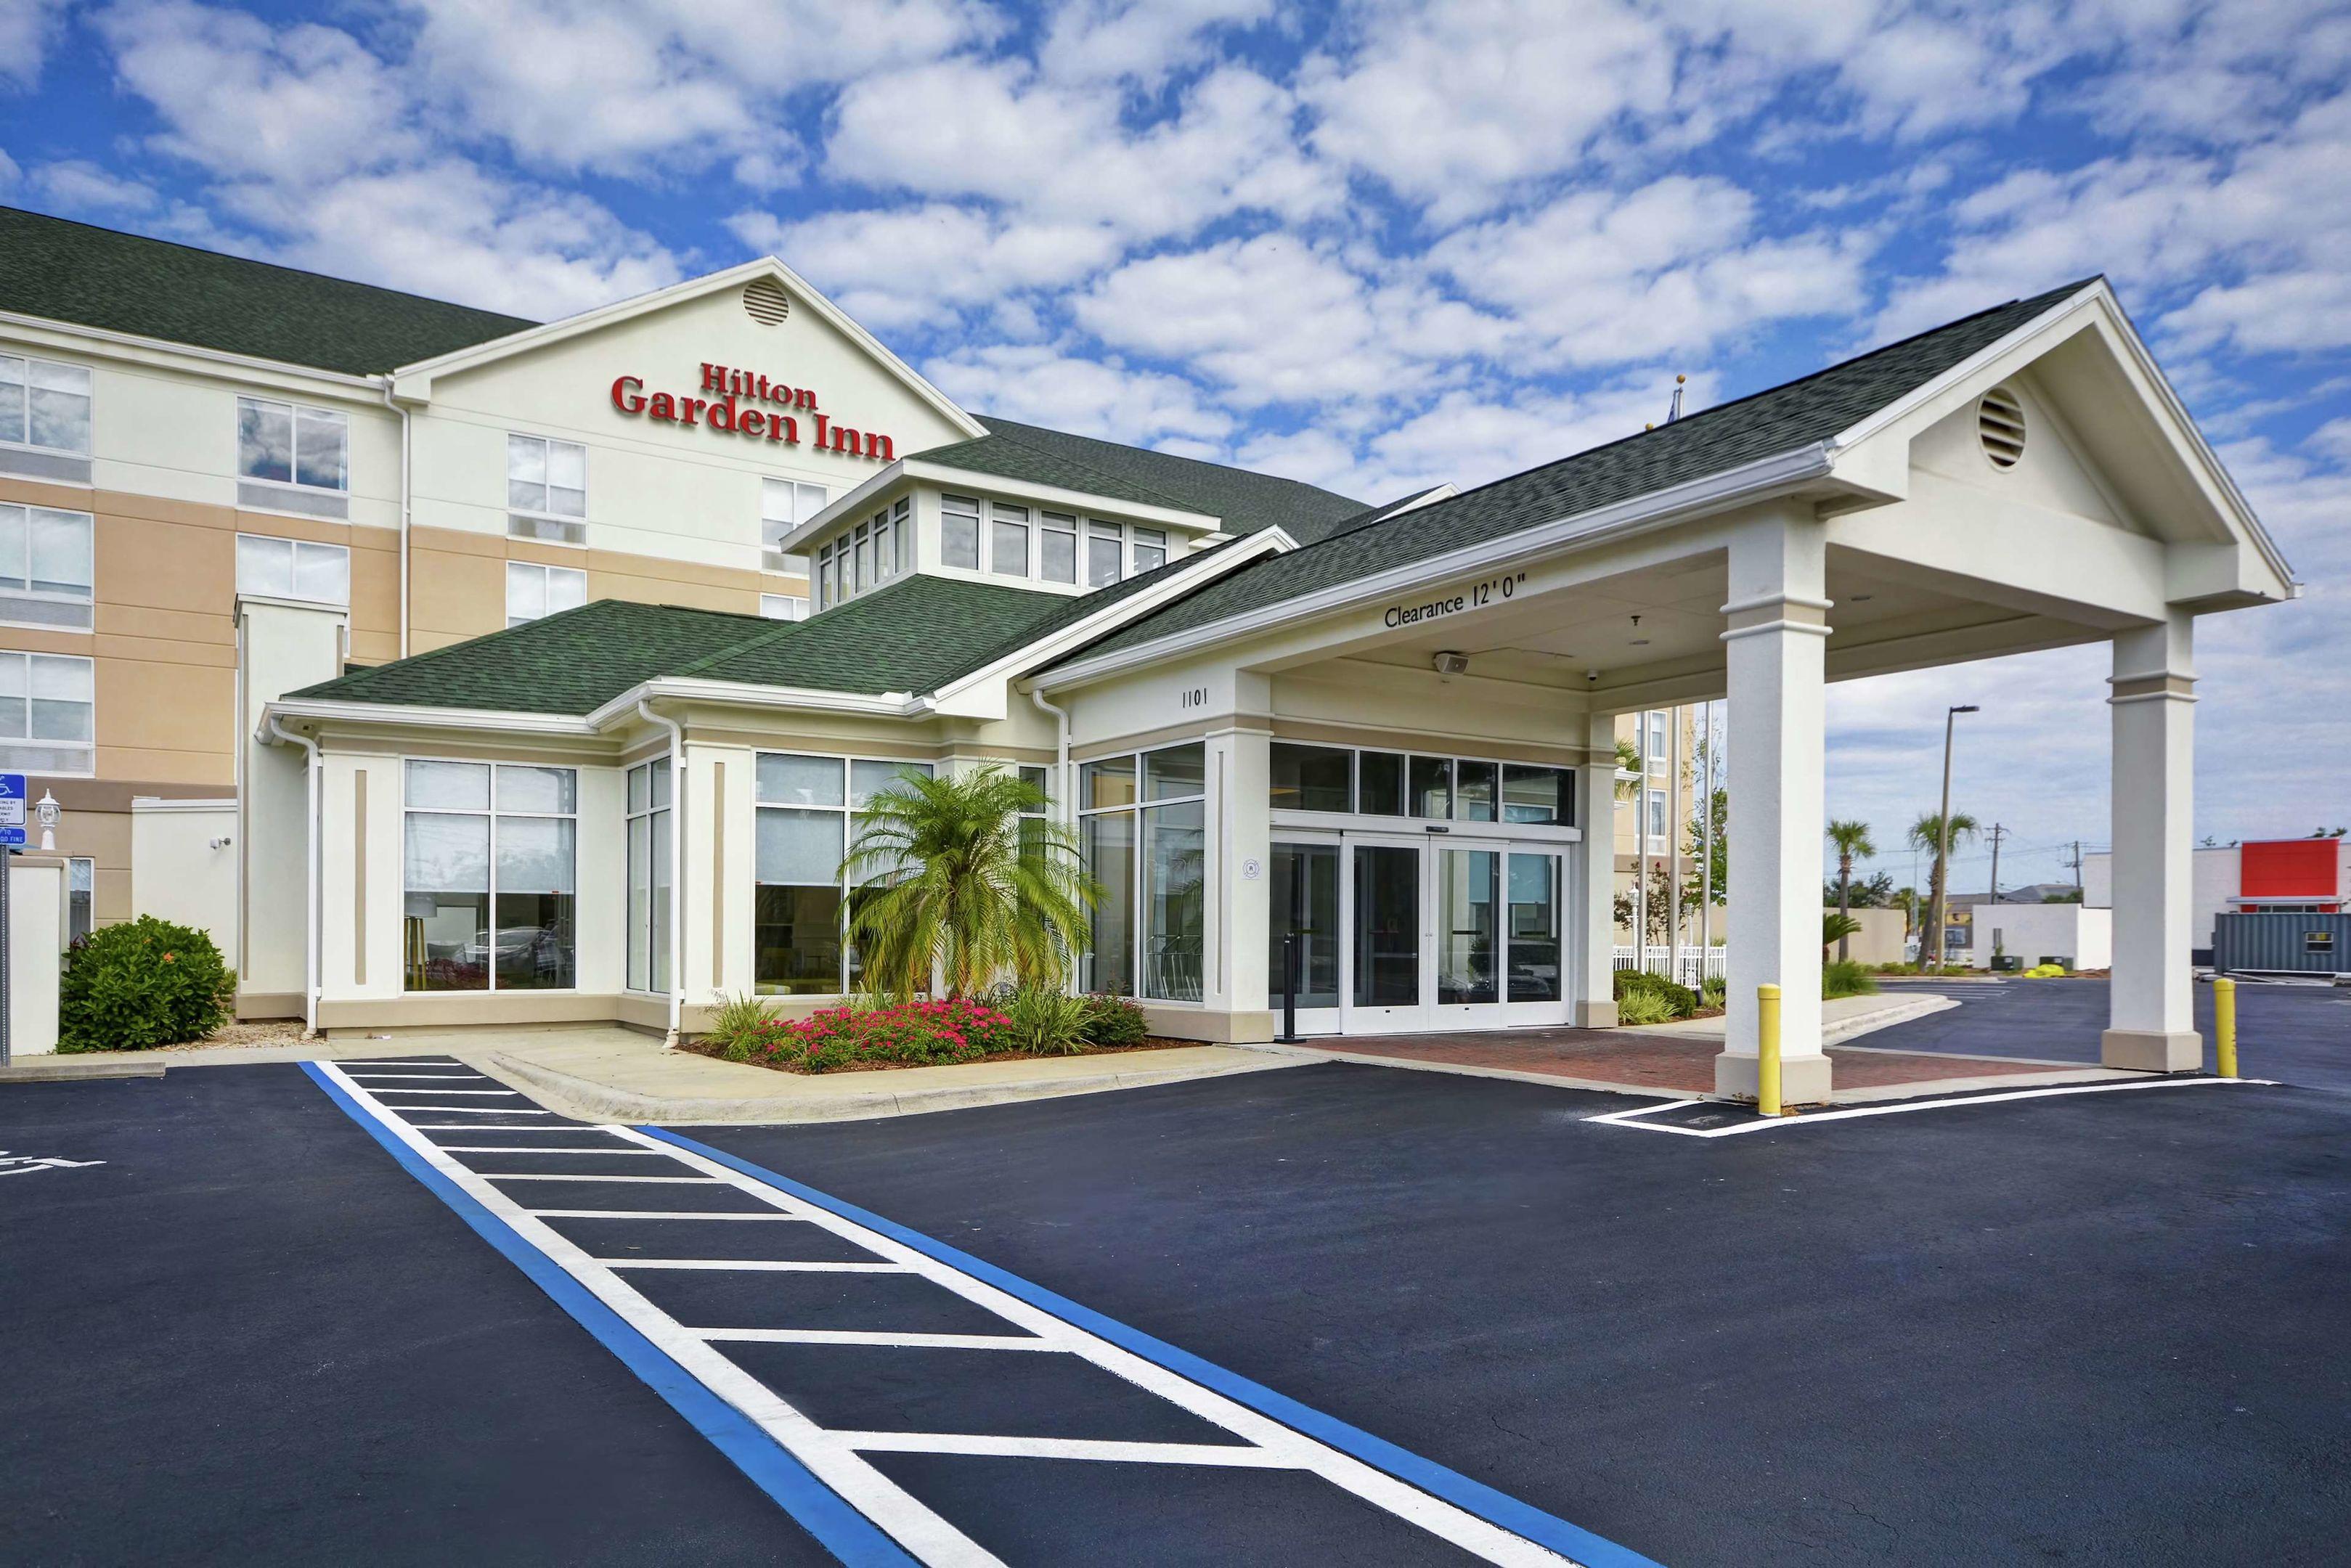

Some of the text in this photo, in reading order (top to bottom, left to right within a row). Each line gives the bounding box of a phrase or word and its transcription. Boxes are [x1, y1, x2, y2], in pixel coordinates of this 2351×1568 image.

[701, 362, 818, 410] Hilton
[611, 375, 896, 460] Garden Inn
[1385, 596, 1464, 628] Clearance
[1183, 687, 1207, 709] 1101
